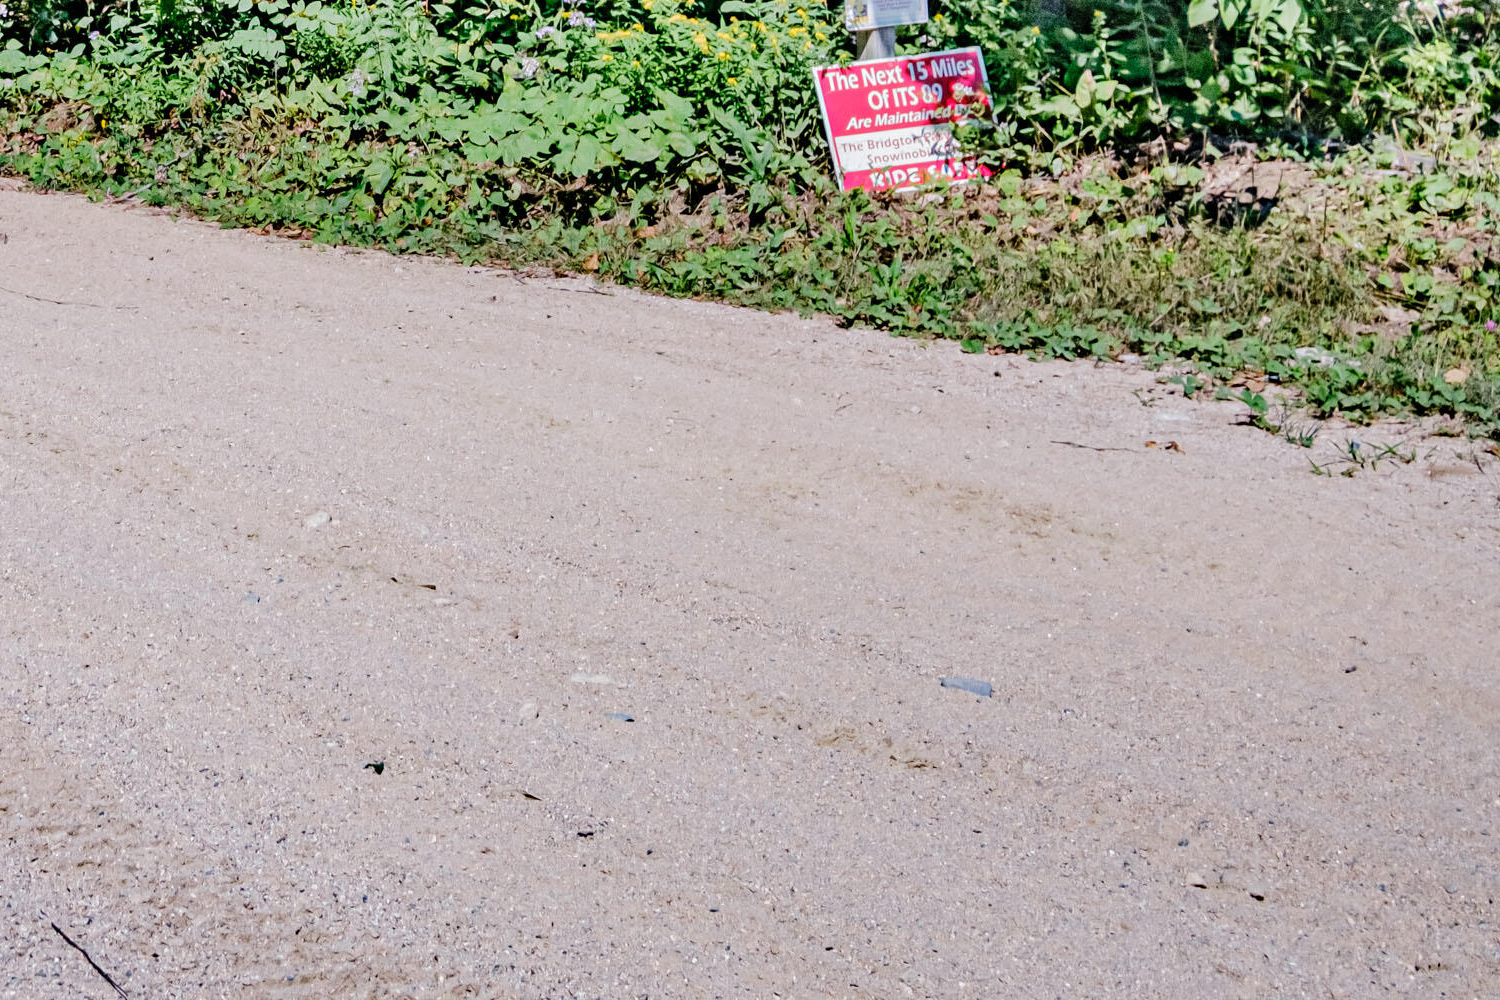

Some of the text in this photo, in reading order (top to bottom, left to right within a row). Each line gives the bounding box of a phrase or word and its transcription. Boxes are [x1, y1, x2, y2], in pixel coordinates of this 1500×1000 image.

[825, 57, 975, 92] The Next 15 Miles
[868, 83, 943, 110] Of ITS 89
[846, 116, 872, 130] Are
[875, 106, 952, 126] Maintained
[841, 142, 864, 153] The
[869, 167, 922, 187] RIDE
